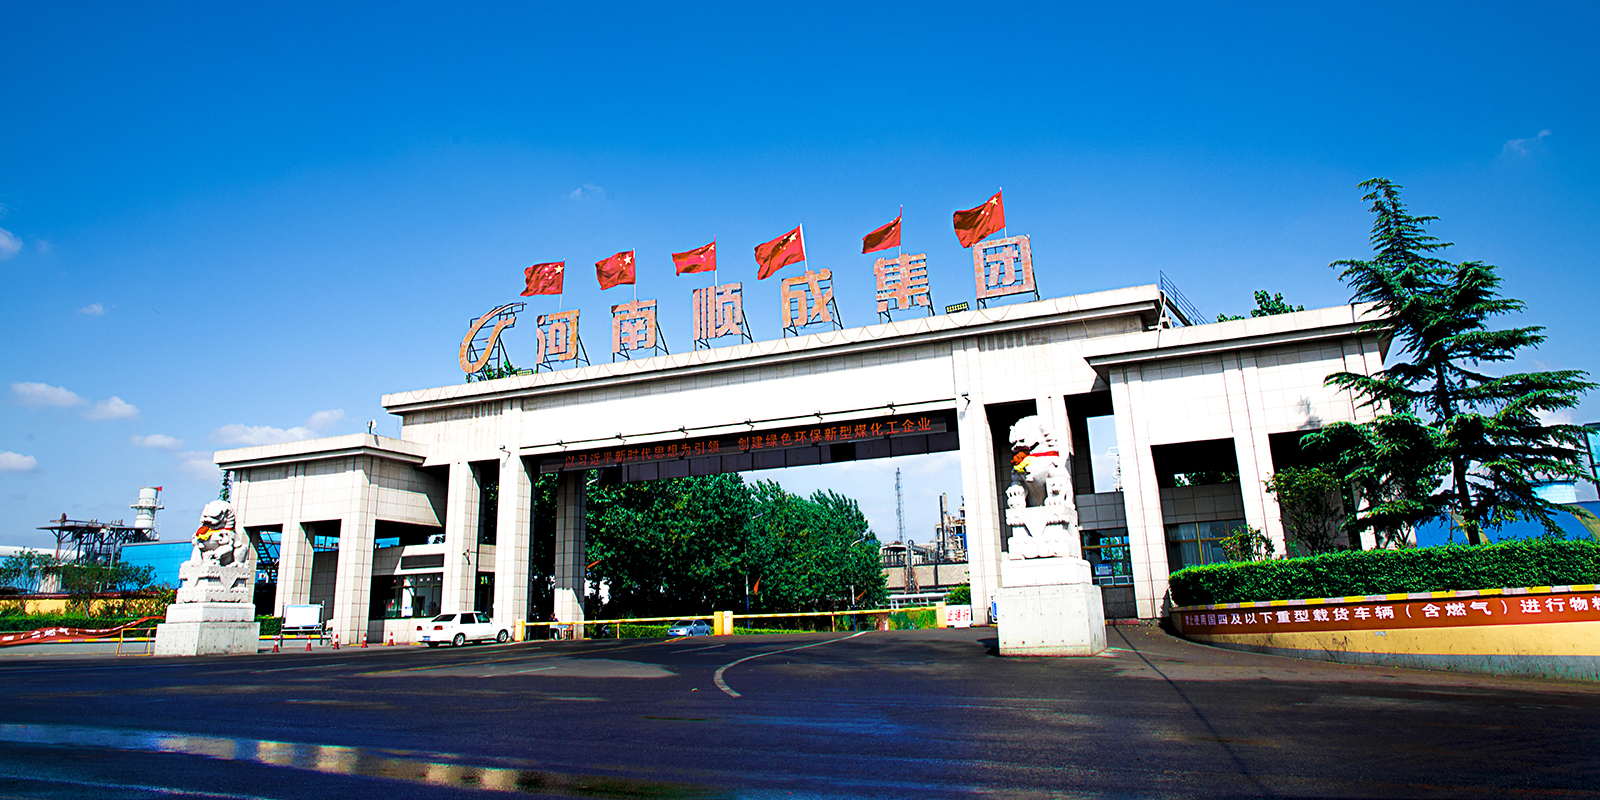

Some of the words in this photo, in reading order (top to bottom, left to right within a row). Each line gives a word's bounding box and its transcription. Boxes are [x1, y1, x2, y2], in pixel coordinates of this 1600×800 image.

[536, 234, 1035, 364] 河南顺成集团
[565, 440, 719, 468] 以习近平新时代思想为引领
[737, 417, 931, 451] 创建绿色环保新型煤化工企业
